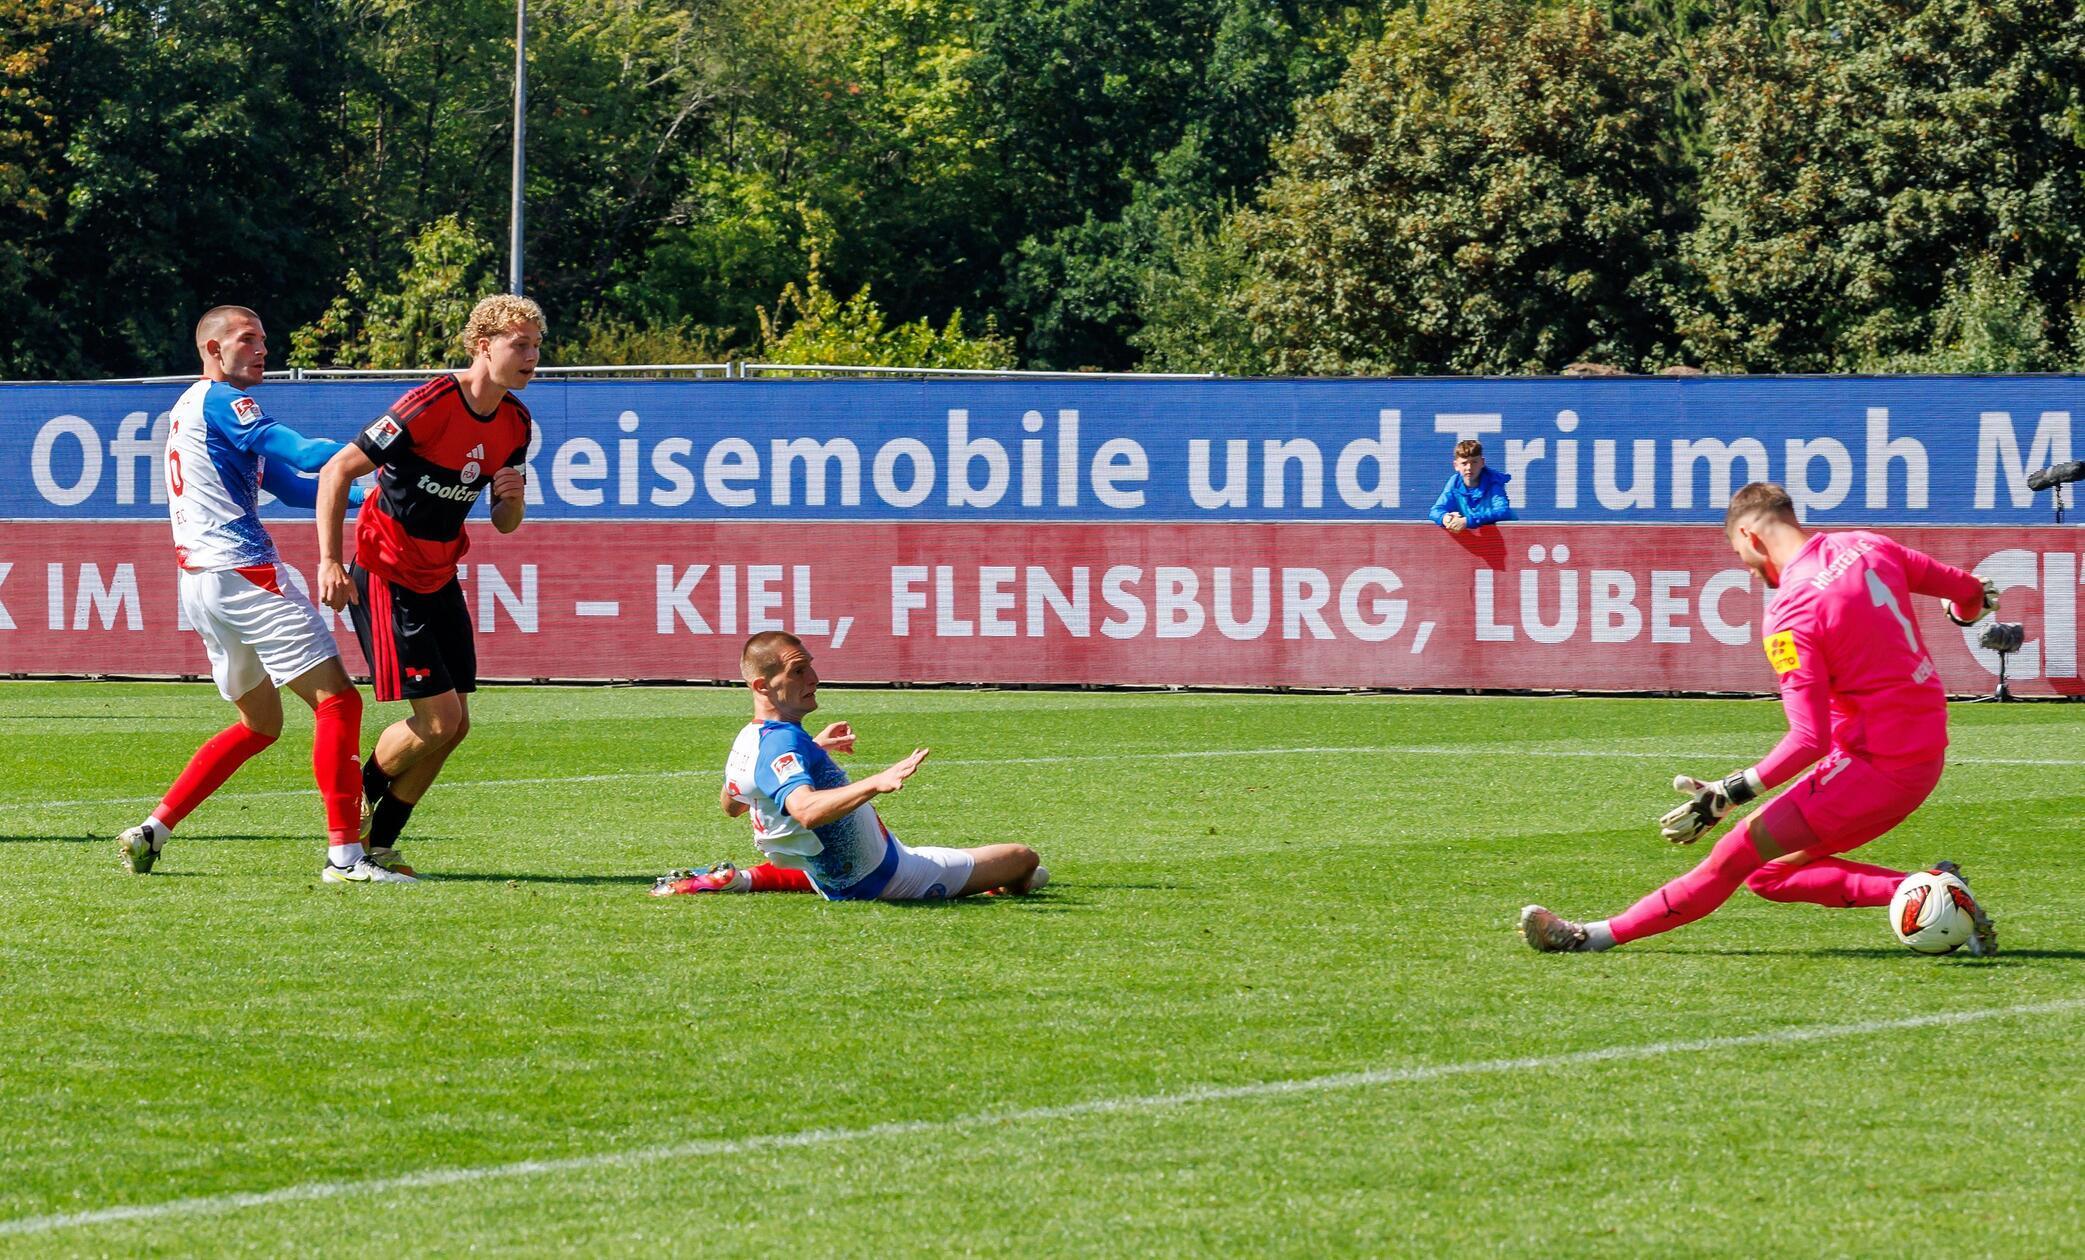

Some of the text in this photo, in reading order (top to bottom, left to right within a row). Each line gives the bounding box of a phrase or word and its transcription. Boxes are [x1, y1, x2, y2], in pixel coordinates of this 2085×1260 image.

[1188, 408, 1401, 509] und
[1434, 406, 1929, 524] Triumph
[47, 562, 144, 631] IM
[656, 564, 854, 649] KIEL,
[891, 566, 1436, 654] FLENSBURG,
[1475, 544, 1783, 645] LÜBEC
[1864, 567, 1919, 653] 1
